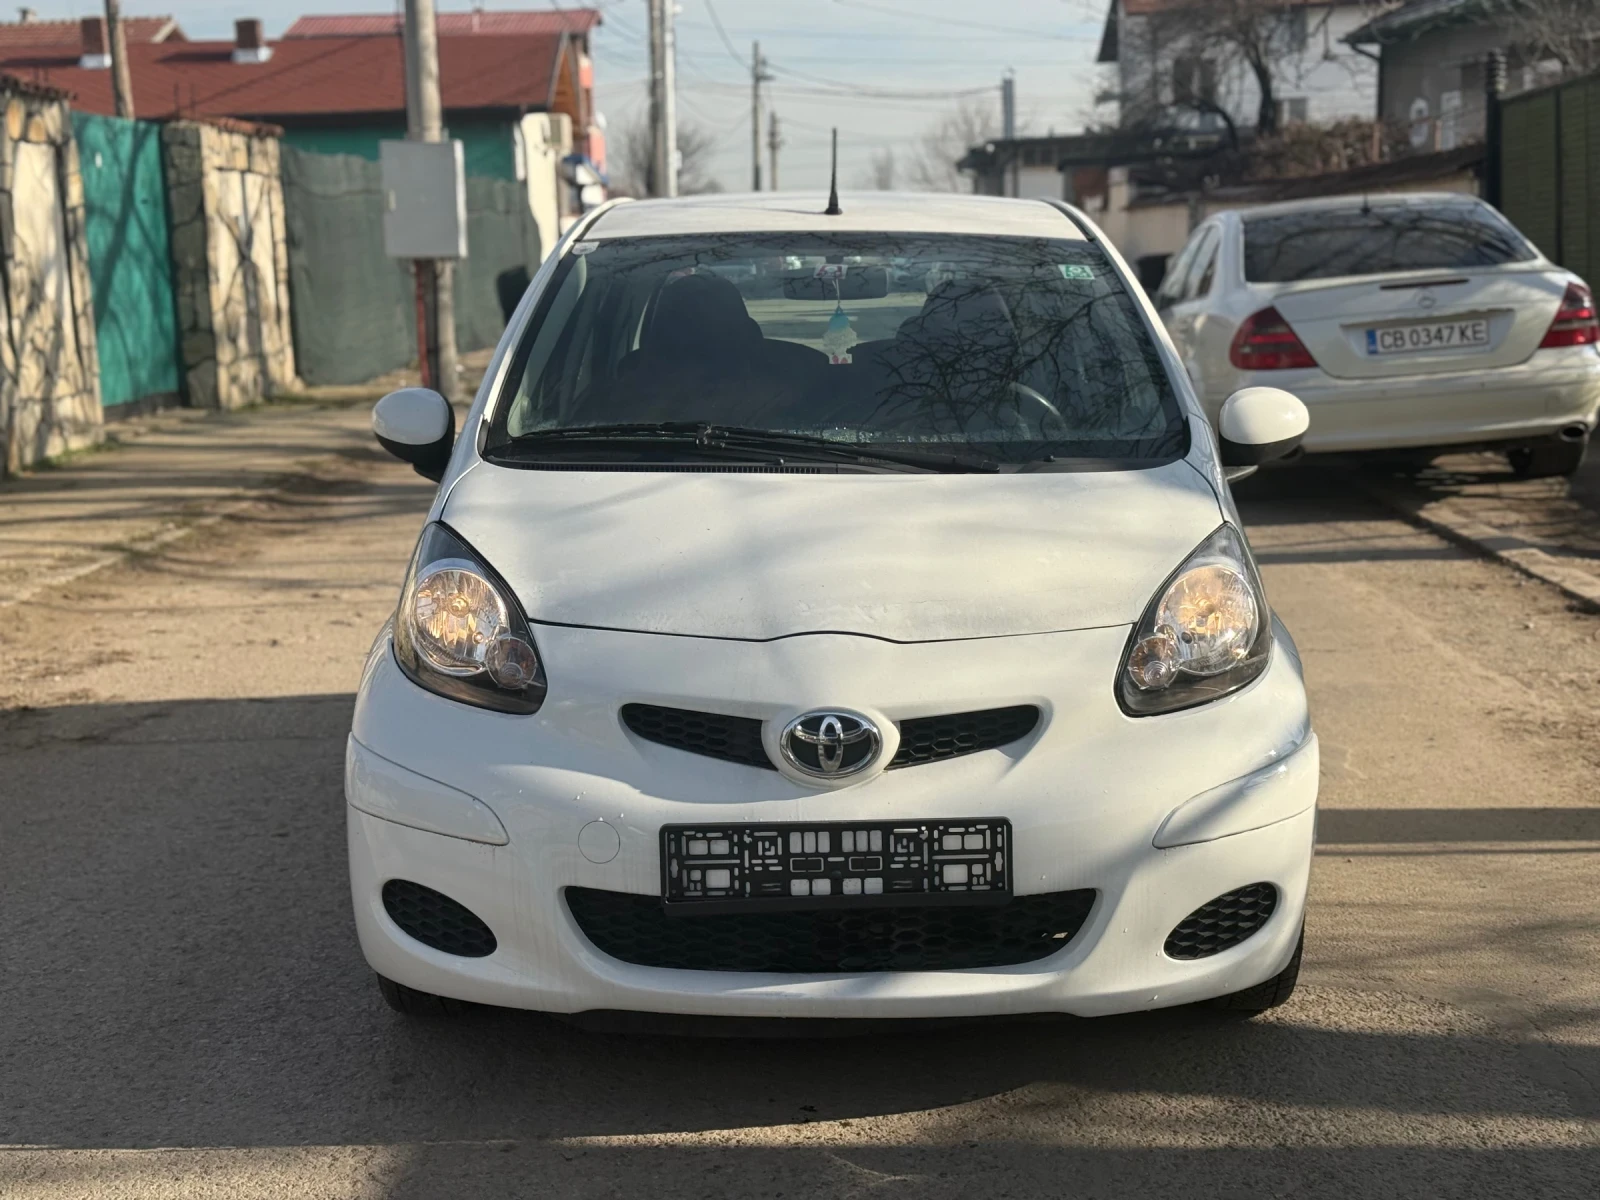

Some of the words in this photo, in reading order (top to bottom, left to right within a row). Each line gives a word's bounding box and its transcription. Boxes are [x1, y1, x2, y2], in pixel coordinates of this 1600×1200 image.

[1380, 329, 1405, 350] CB
[1409, 325, 1454, 347] 0347
[1459, 323, 1485, 342] KE
